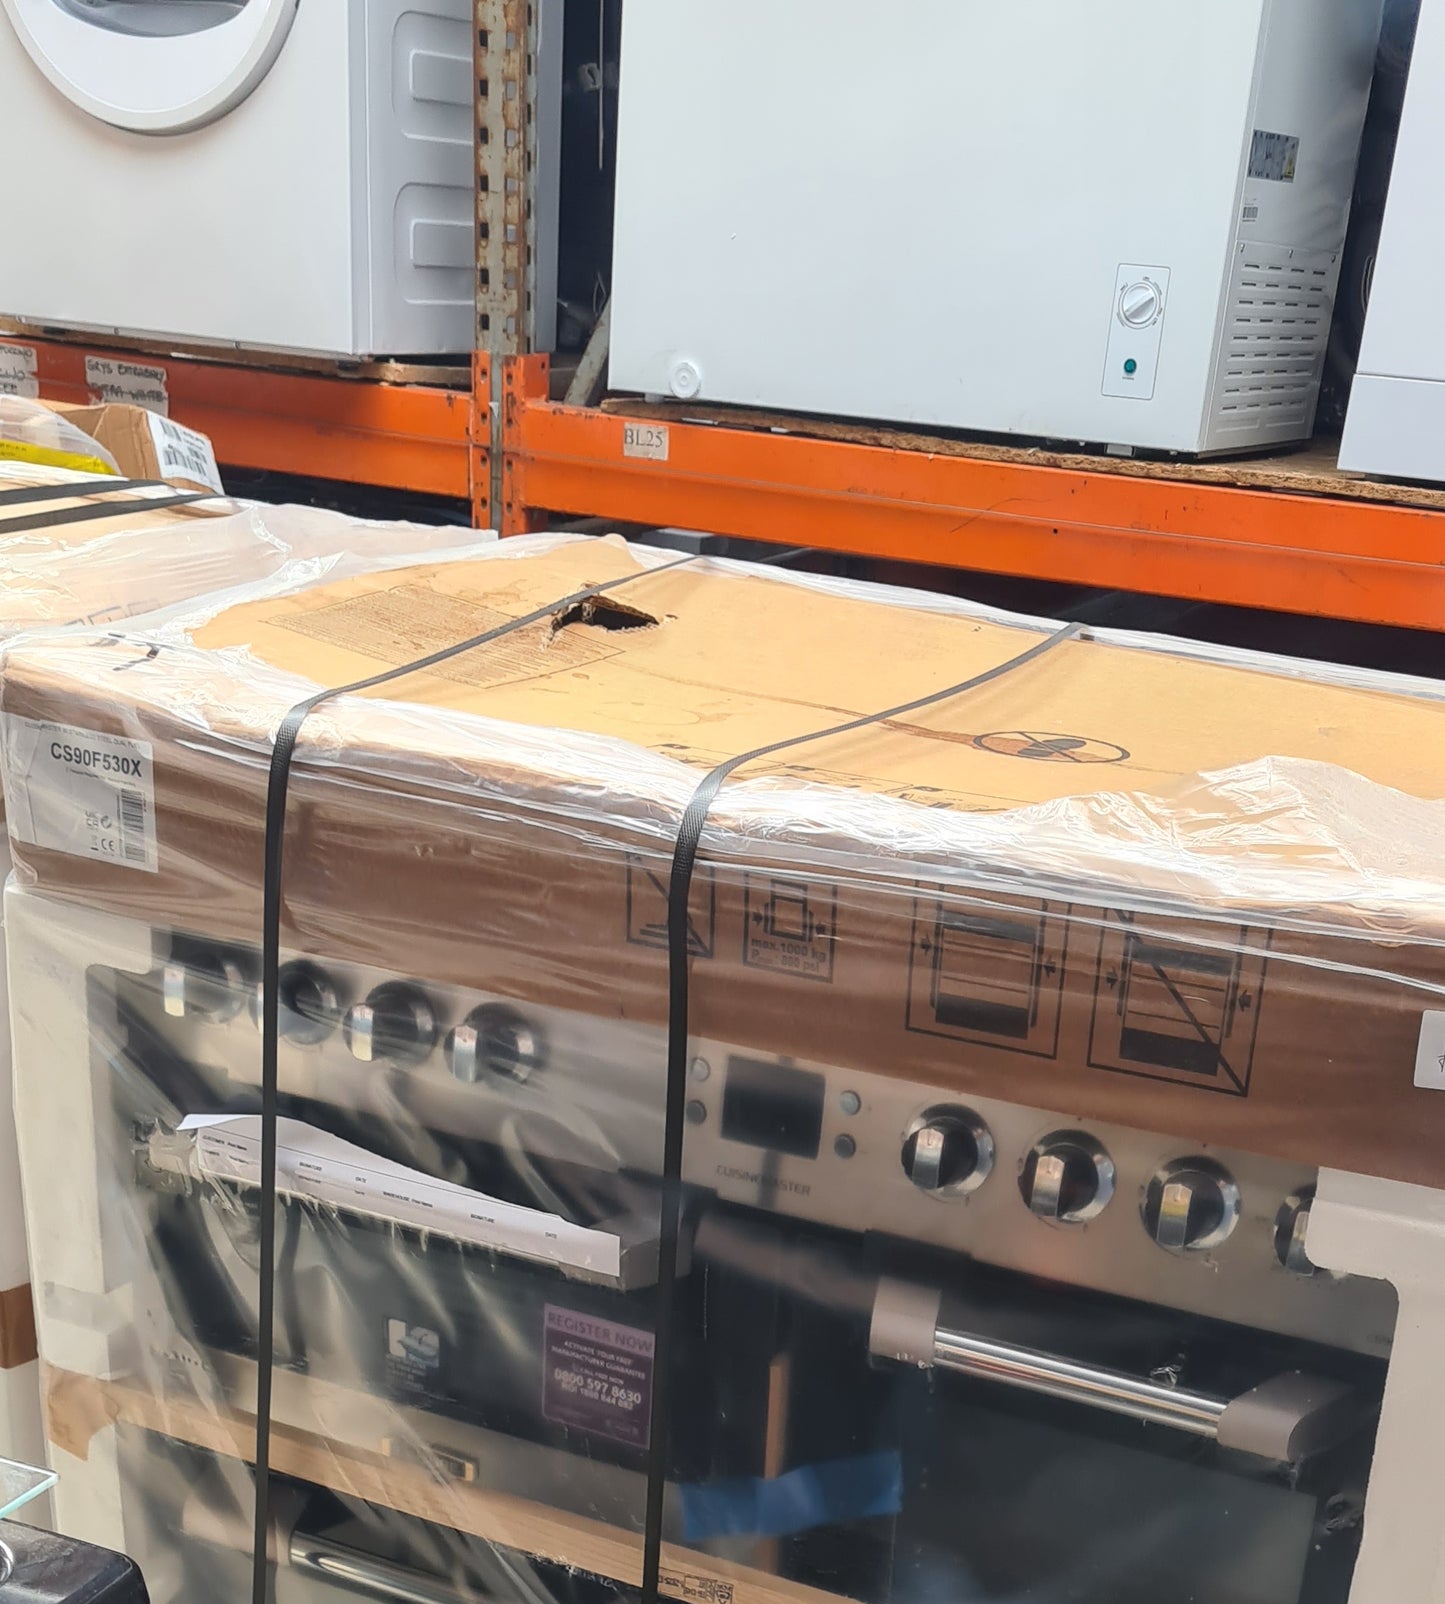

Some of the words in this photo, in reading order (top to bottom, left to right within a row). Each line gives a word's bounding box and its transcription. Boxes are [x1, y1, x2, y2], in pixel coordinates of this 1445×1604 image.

[624, 428, 664, 448] BL25
[50, 742, 142, 778] CS90F530X
[548, 1311, 611, 1340] REGISTER
[615, 1334, 654, 1352] NOW
[586, 1378, 610, 1395] 597
[611, 1385, 643, 1405] 8630
